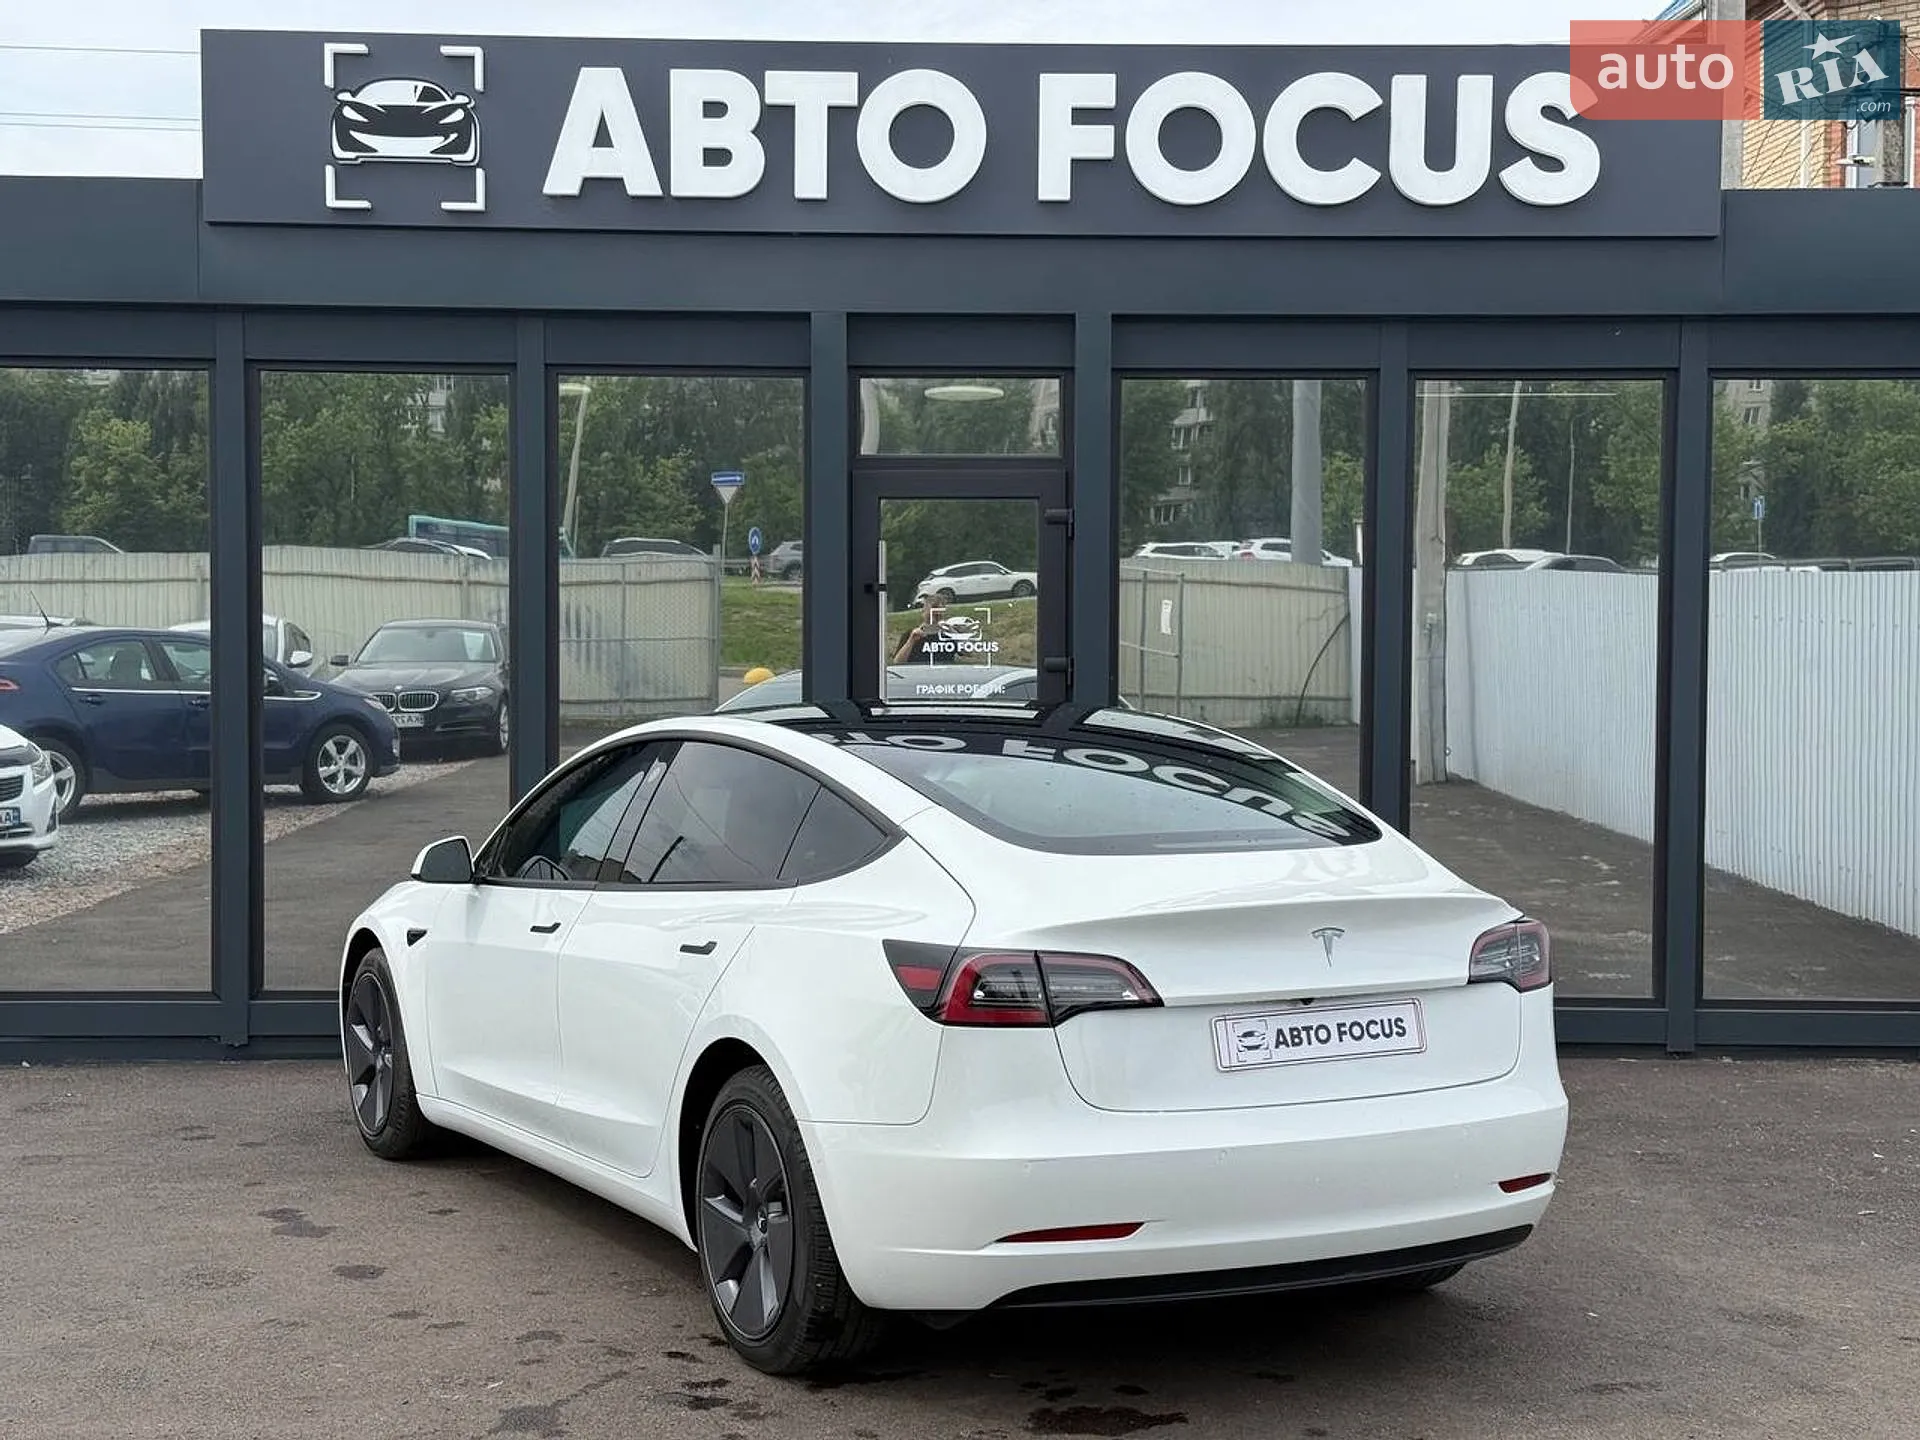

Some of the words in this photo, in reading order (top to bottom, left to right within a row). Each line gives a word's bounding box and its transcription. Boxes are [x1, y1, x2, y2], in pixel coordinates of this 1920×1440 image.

[542, 67, 987, 203] АВТО
[1037, 71, 1601, 206] FOCUS
[957, 641, 999, 653] FOCUS
[1274, 1023, 1332, 1049] АВТО
[1337, 1016, 1407, 1043] FOCUS
